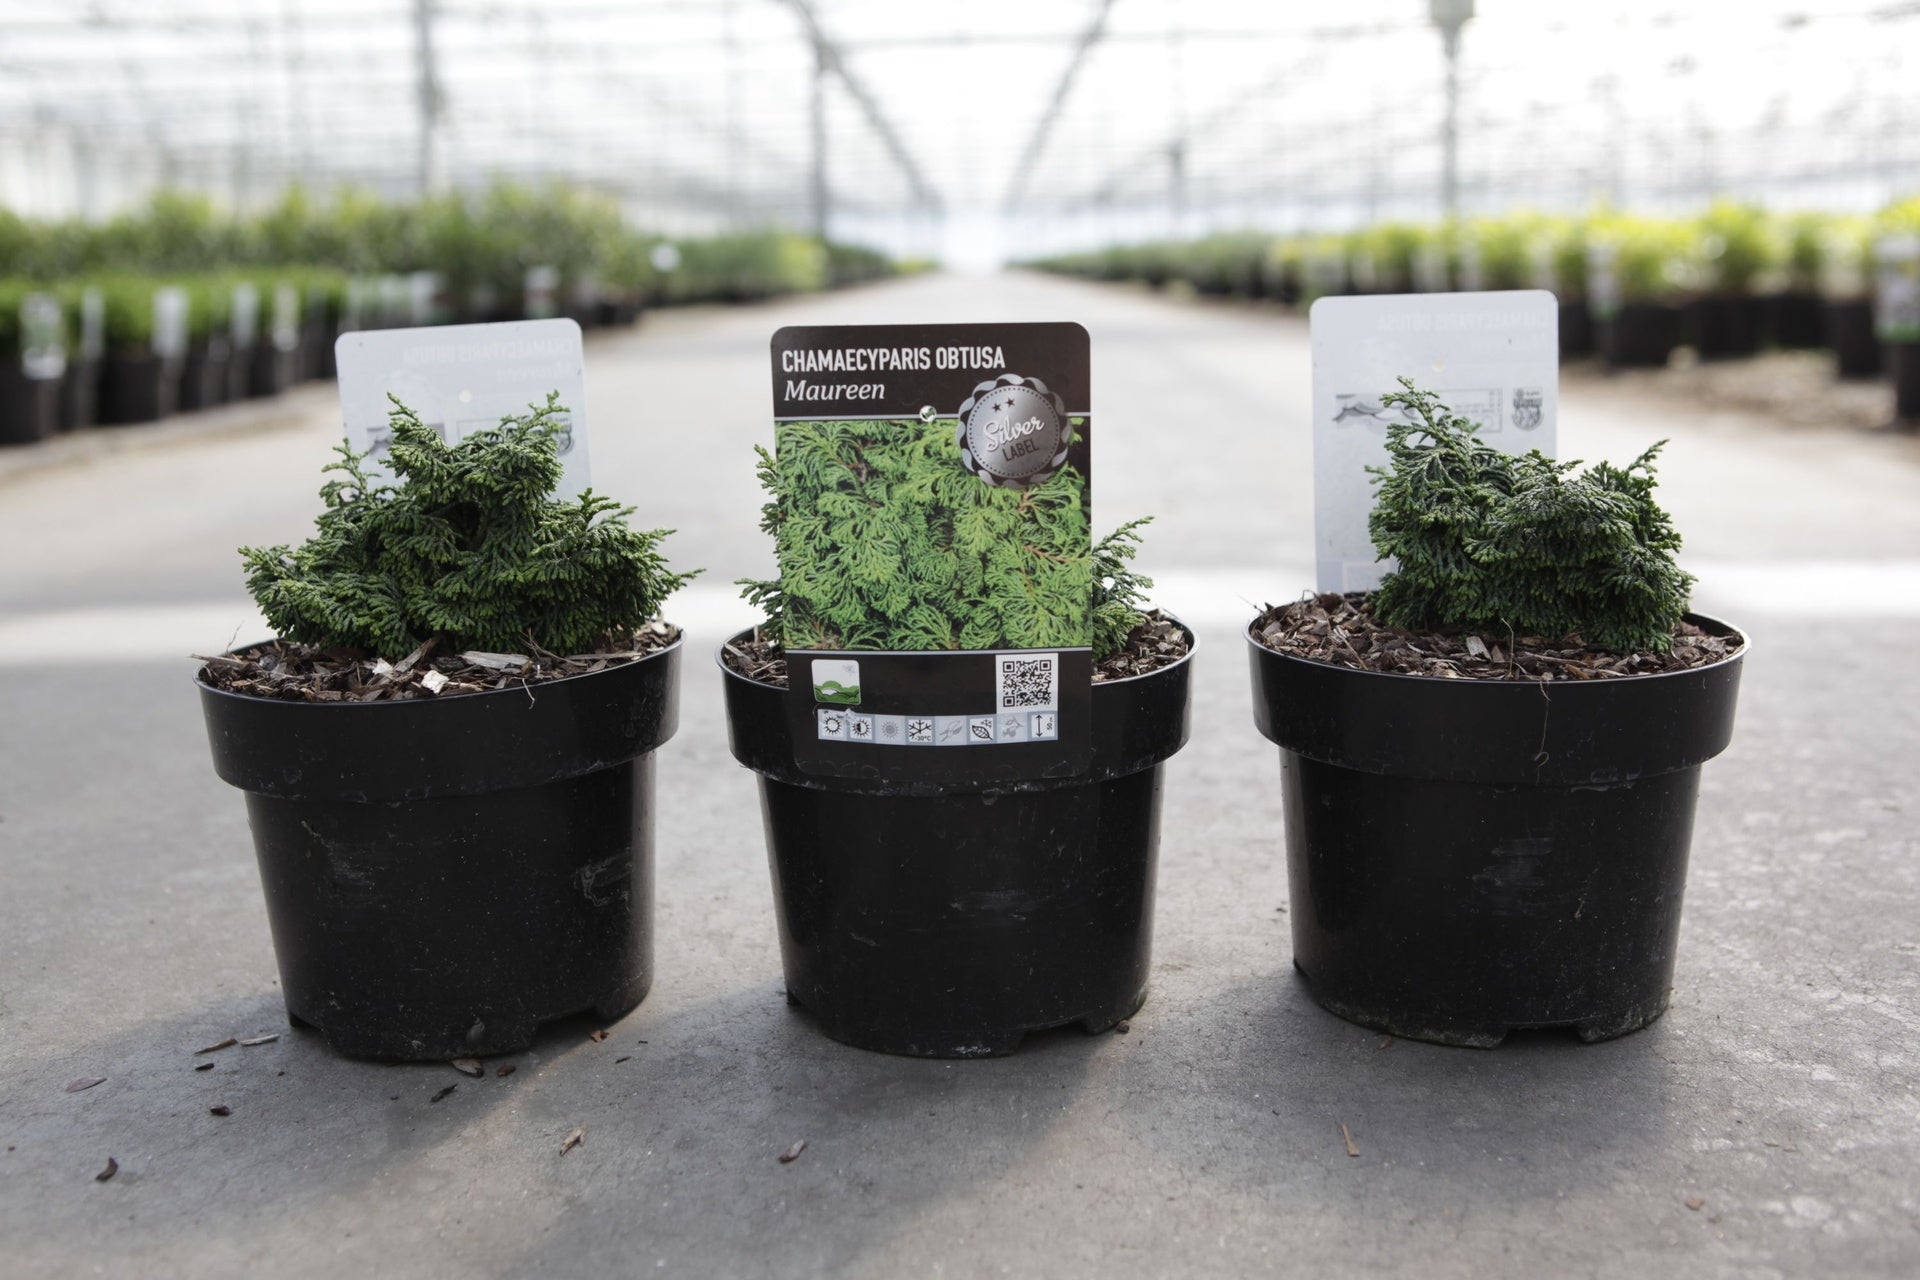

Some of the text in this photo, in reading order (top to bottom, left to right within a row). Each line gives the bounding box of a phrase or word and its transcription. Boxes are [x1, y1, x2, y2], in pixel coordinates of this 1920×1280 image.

[782, 346, 1006, 373] CHAMAECYPARIS OBTUSA
[784, 379, 885, 401] Maureen
[984, 415, 1045, 452] Silver
[1002, 438, 1040, 462] LABEL
